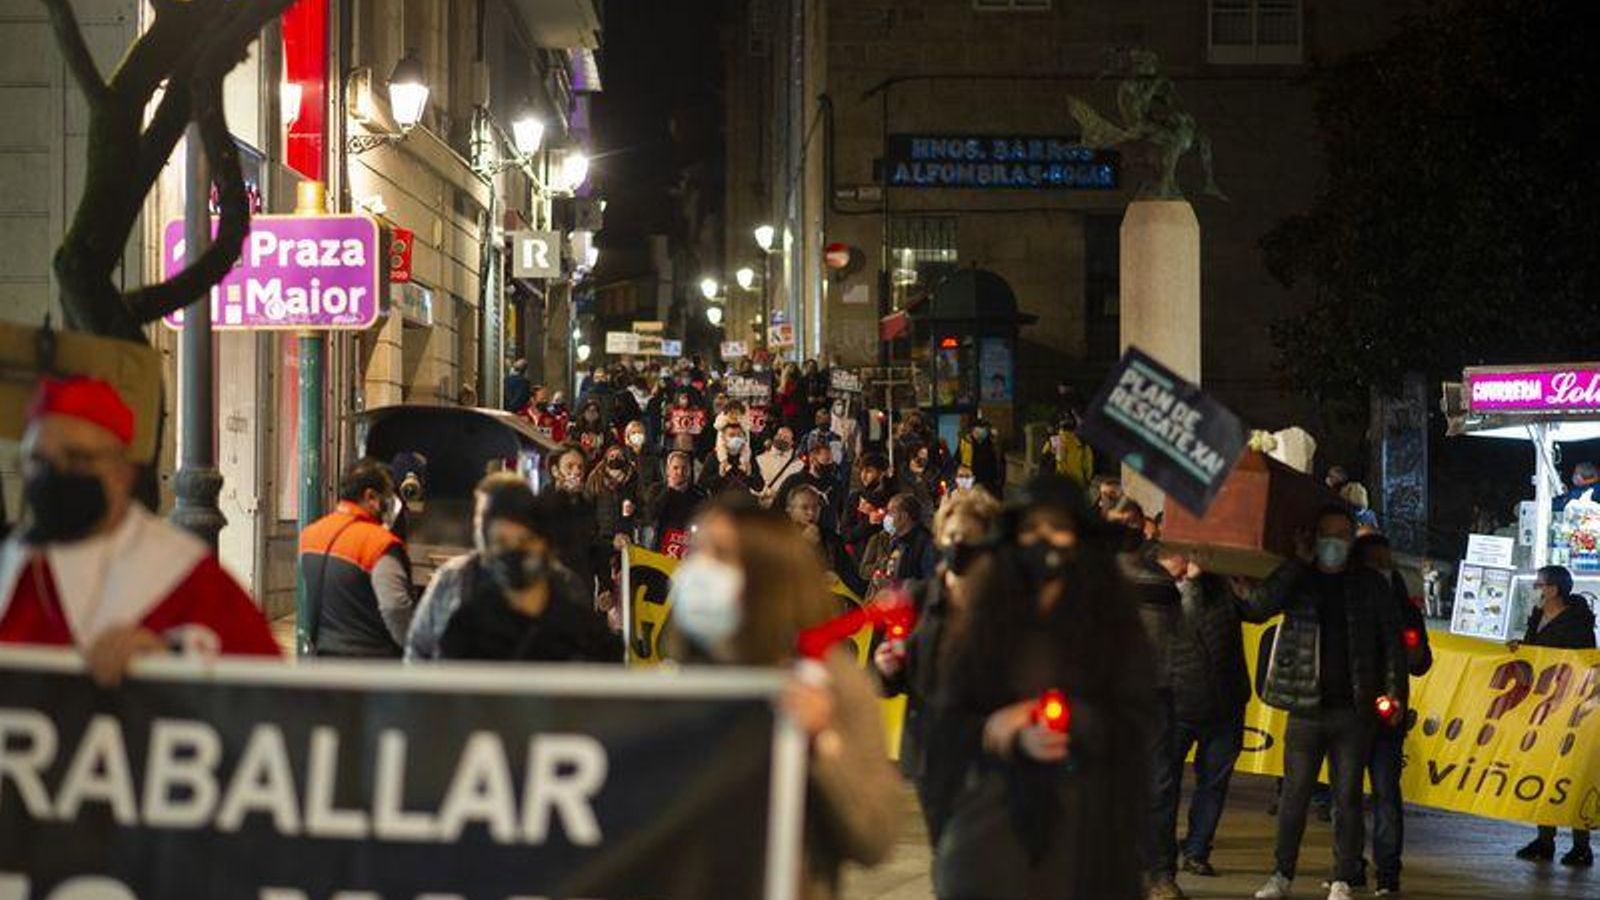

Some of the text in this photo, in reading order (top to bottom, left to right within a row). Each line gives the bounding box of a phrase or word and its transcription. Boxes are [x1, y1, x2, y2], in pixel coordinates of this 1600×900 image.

[250, 230, 366, 268] Praza
[522, 239, 550, 269] R
[246, 277, 367, 316] Maior
[1107, 386, 1196, 451] RESCATE
[1119, 367, 1203, 432] PLAN DE
[1427, 756, 1572, 805] viños
